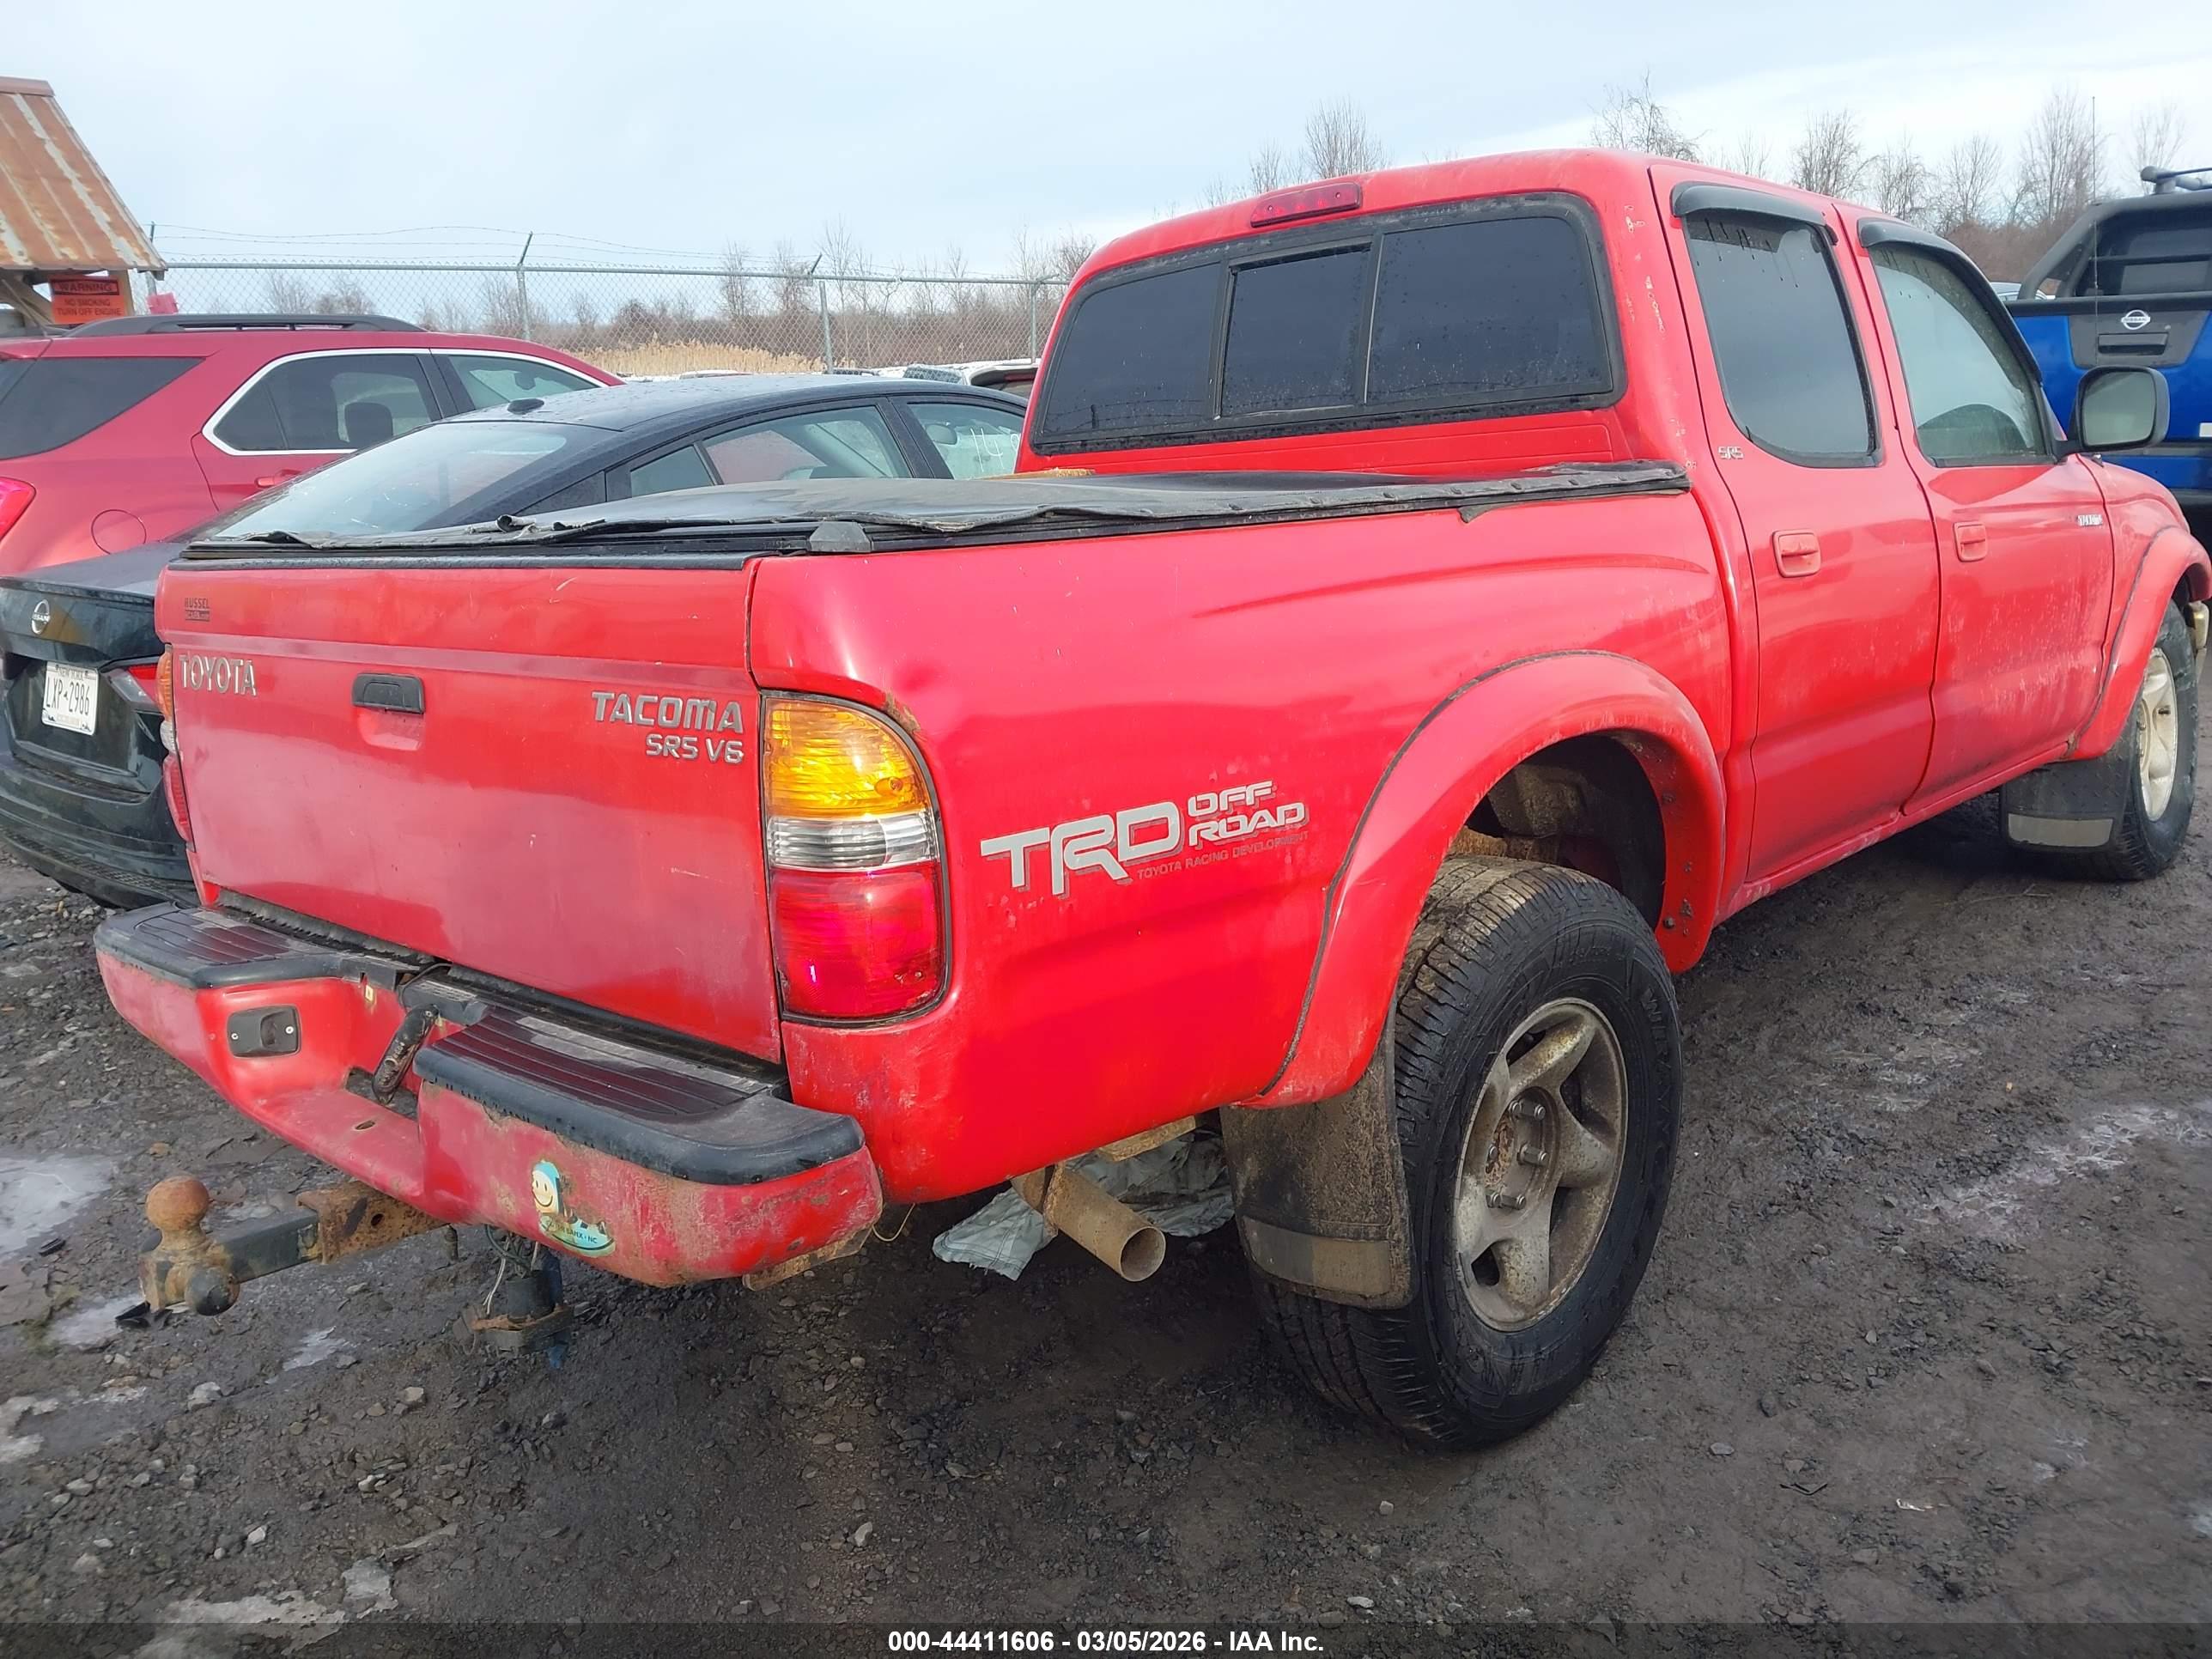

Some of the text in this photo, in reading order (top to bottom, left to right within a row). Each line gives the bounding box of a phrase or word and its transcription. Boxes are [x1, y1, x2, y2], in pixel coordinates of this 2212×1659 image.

[59, 282, 112, 292] WARNING
[64, 298, 111, 307] NO SMOKING
[56, 307, 122, 316] TURN OFF ENGINE
[179, 654, 258, 696] TOYOTA
[46, 676, 90, 716] LXP 2986
[591, 690, 744, 734] TACOMA
[646, 733, 744, 764] SR5 V6
[1187, 780, 1277, 817] OFF
[1188, 802, 1309, 848] ROAD
[980, 800, 1184, 898] TRD
[1137, 830, 1309, 880] TOYOTA RACING DEVELOPMENT
